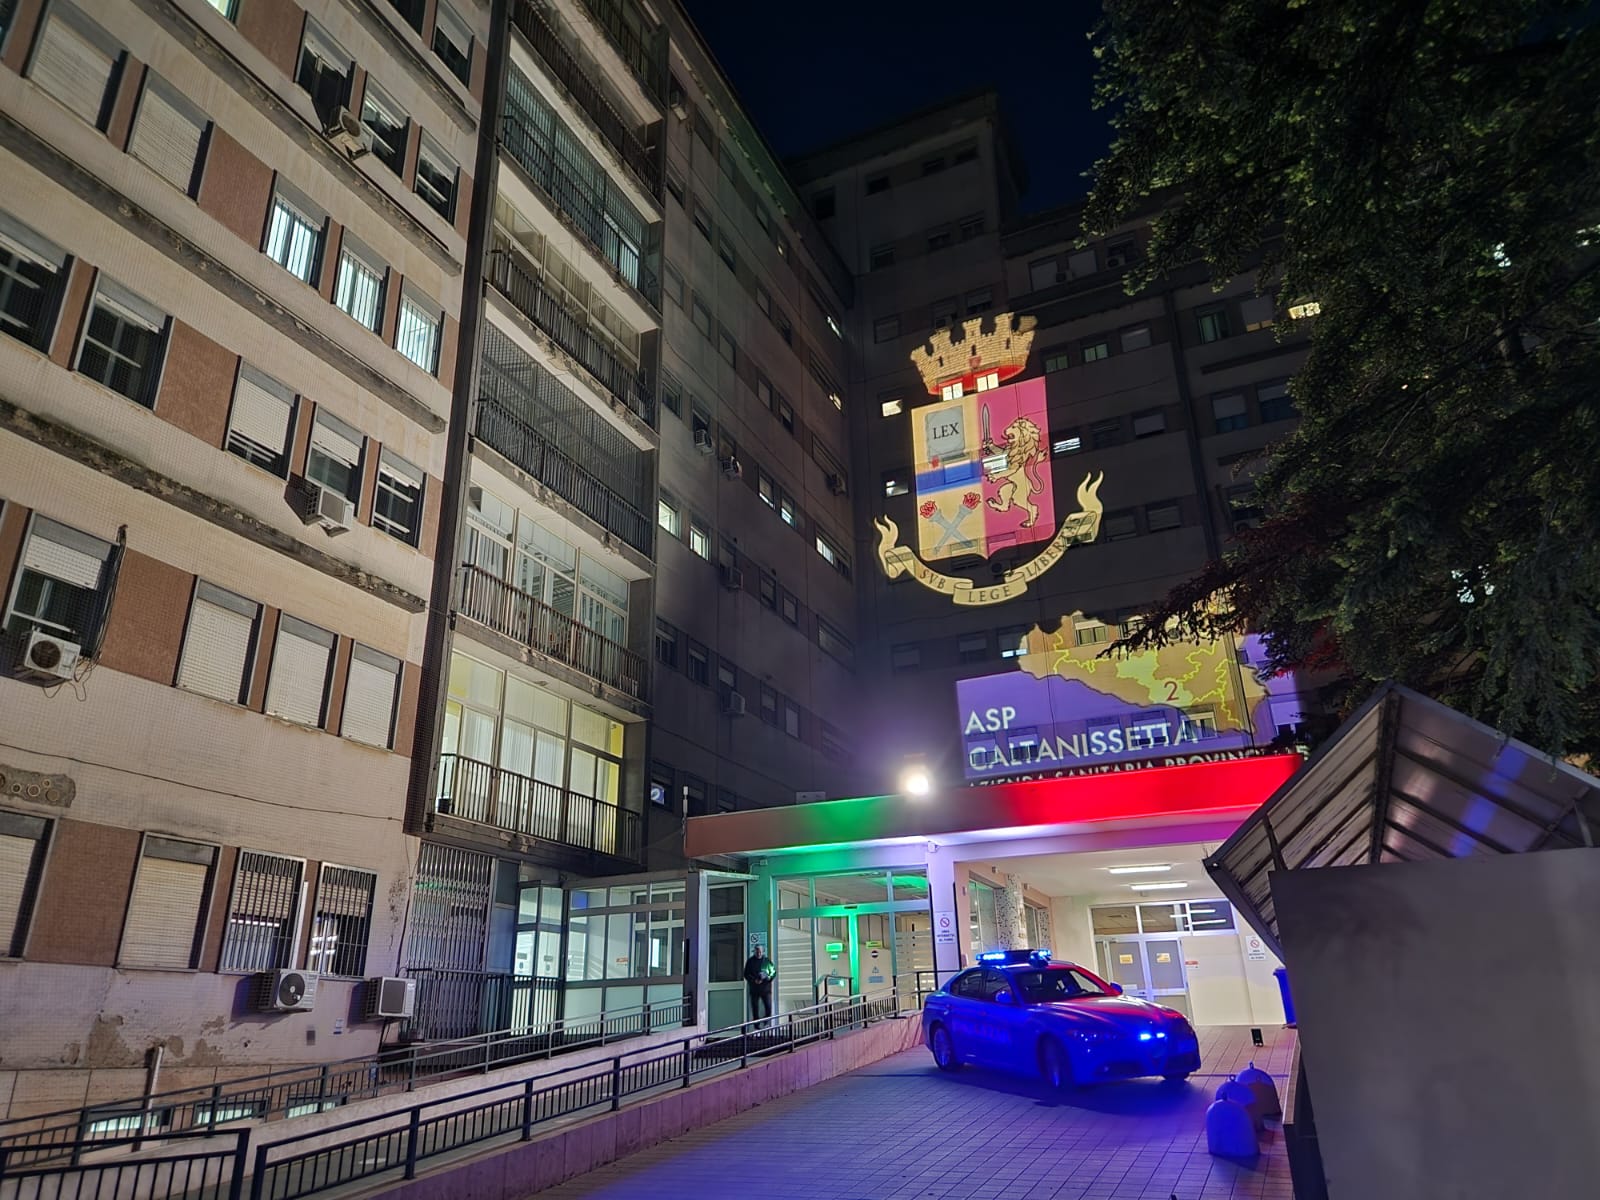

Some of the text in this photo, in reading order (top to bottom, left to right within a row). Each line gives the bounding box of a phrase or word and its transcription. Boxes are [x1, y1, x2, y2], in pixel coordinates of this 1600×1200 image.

[933, 422, 959, 439] LEX
[920, 570, 946, 589] SVB
[968, 585, 1012, 602] LEGE
[1163, 680, 1179, 701] 2
[965, 706, 1016, 734] ASP
[969, 719, 1198, 770] CALTANISSETTA
